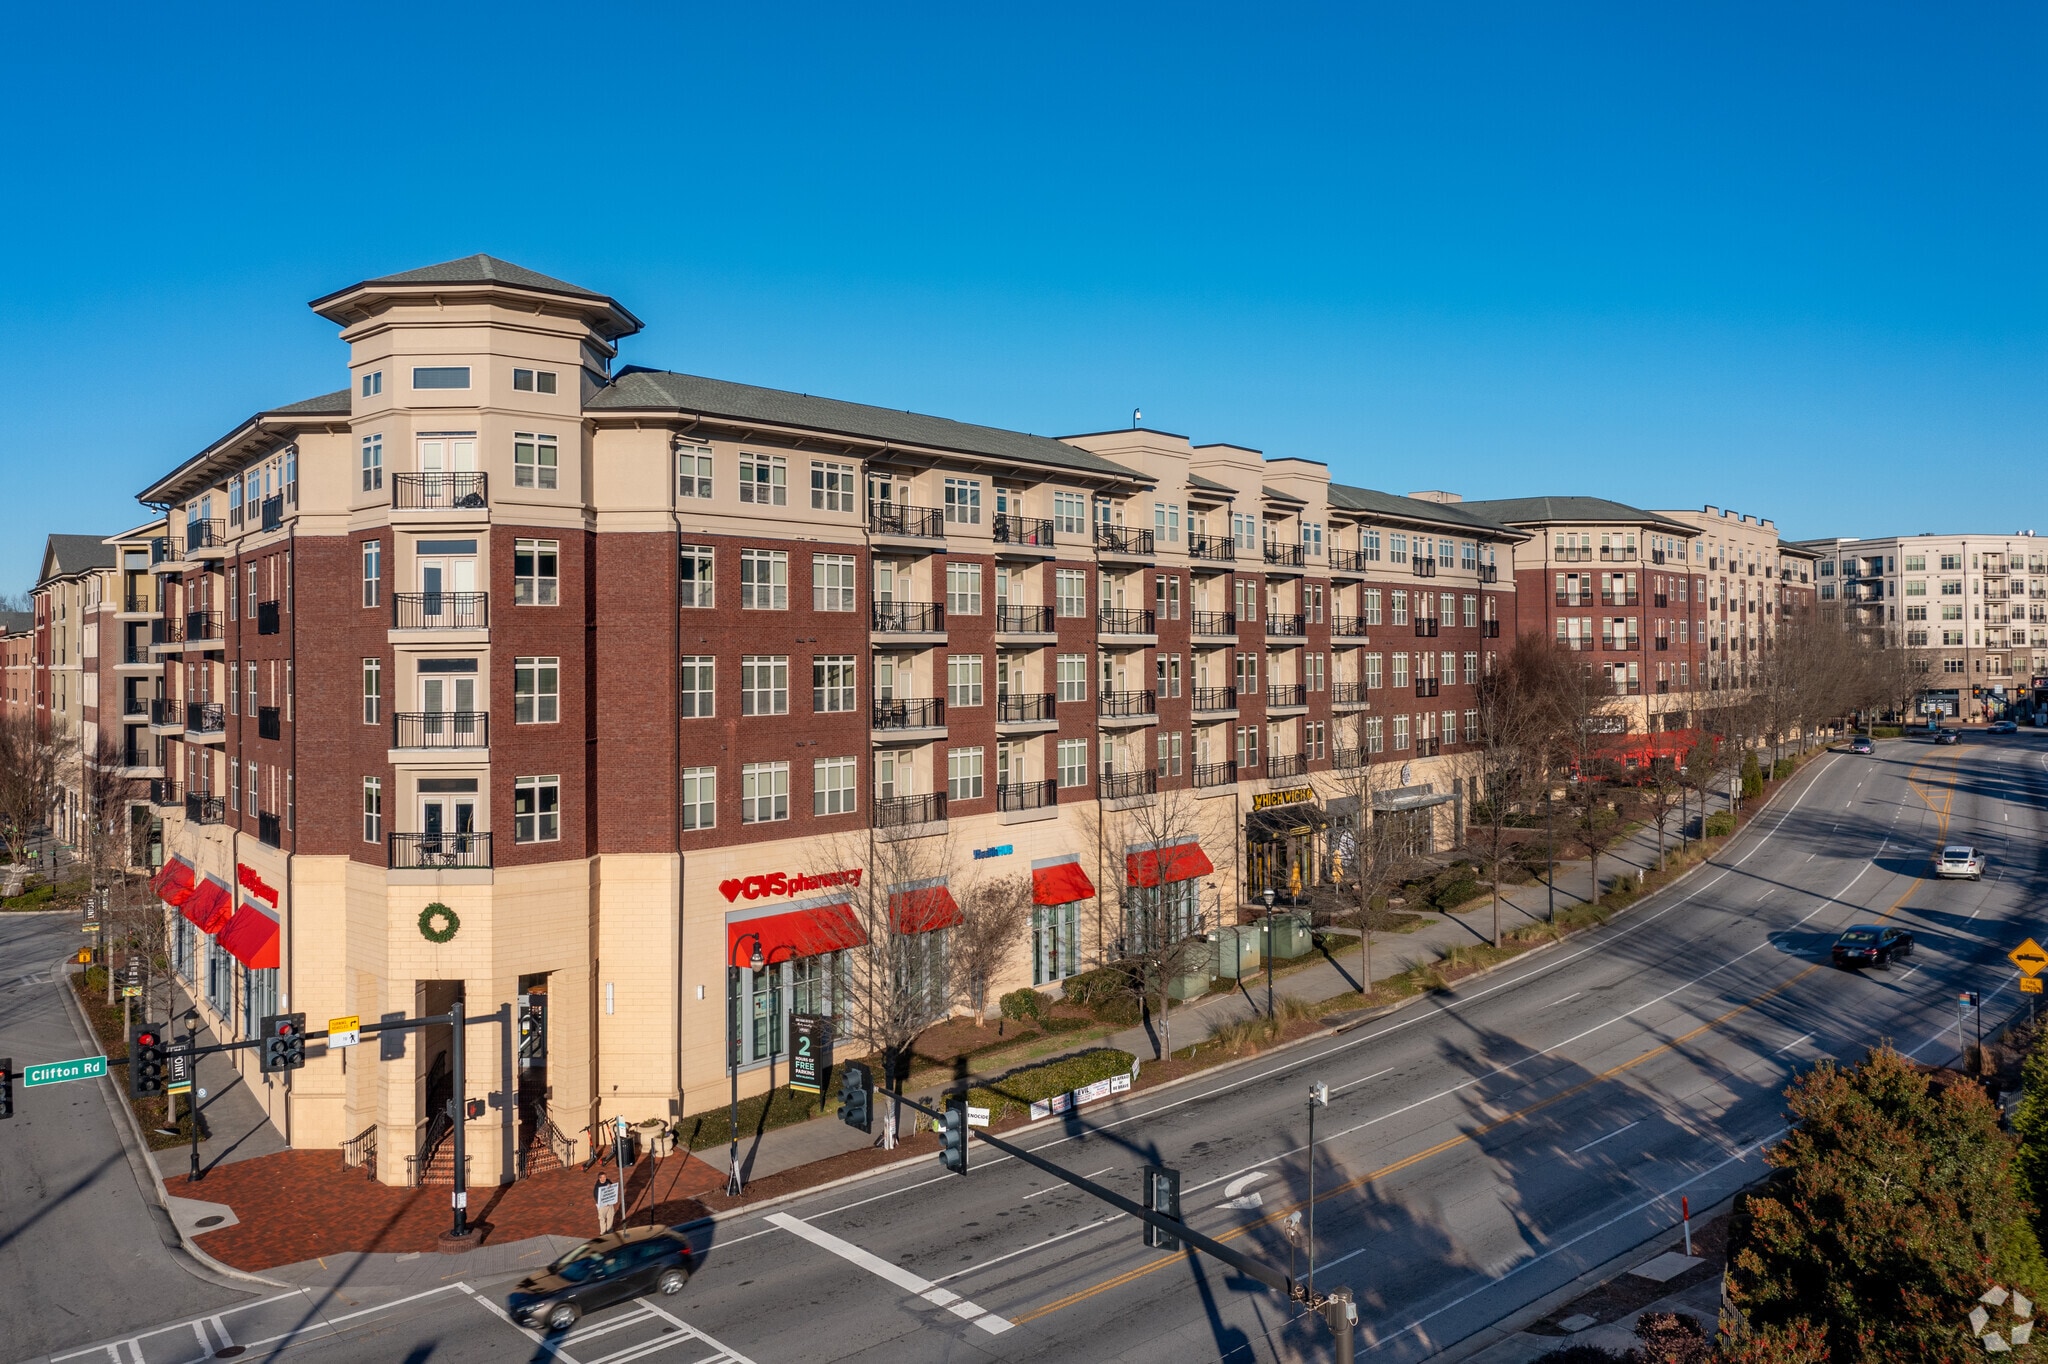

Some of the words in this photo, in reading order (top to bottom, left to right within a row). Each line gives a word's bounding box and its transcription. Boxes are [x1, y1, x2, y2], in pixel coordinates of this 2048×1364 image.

[1253, 792, 1283, 812] WHICH
[1284, 788, 1307, 804] WICH
[742, 872, 787, 900] CVS
[788, 868, 863, 898] pharmacy
[798, 1035, 811, 1057] 2
[31, 1067, 79, 1081] Clifton
[83, 1061, 100, 1074] Rd
[795, 1061, 815, 1071] FREE
[795, 1068, 815, 1076] PARKING
